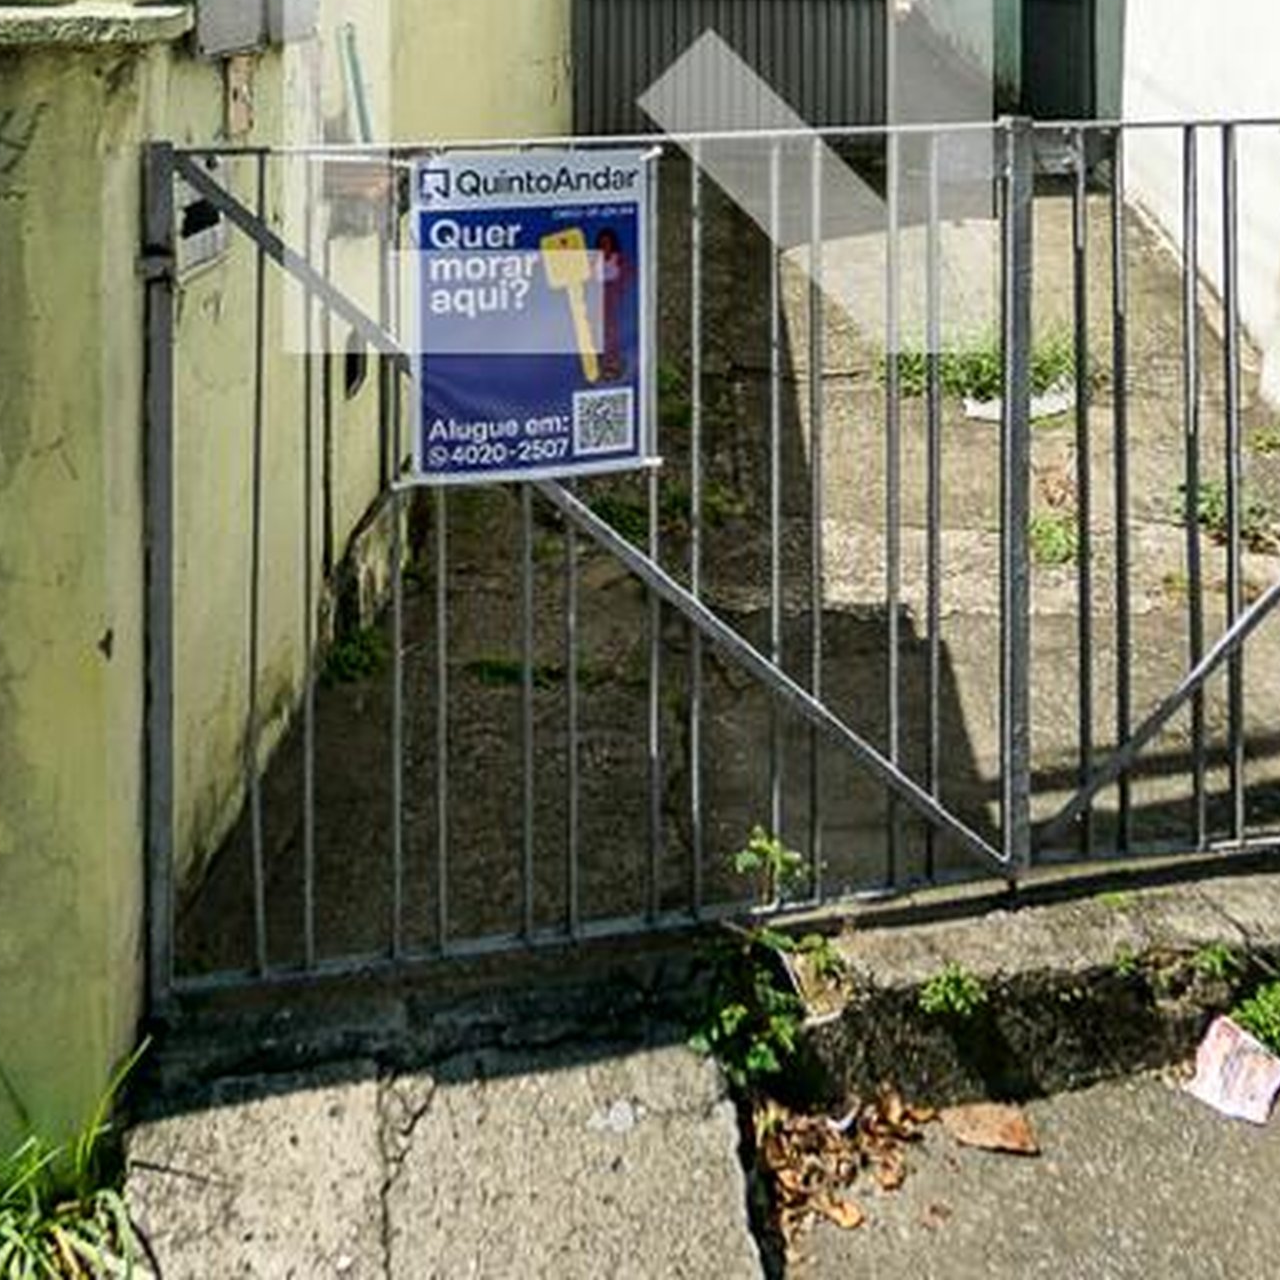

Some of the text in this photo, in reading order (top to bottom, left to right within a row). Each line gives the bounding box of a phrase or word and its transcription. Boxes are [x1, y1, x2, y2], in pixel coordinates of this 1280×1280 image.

[455, 166, 639, 197] QuintoAndar
[429, 218, 521, 249] Quer
[429, 252, 539, 281] morar
[429, 279, 531, 318] aqui?
[428, 416, 570, 444] Alugue em:
[451, 437, 569, 465] 4020-2507
